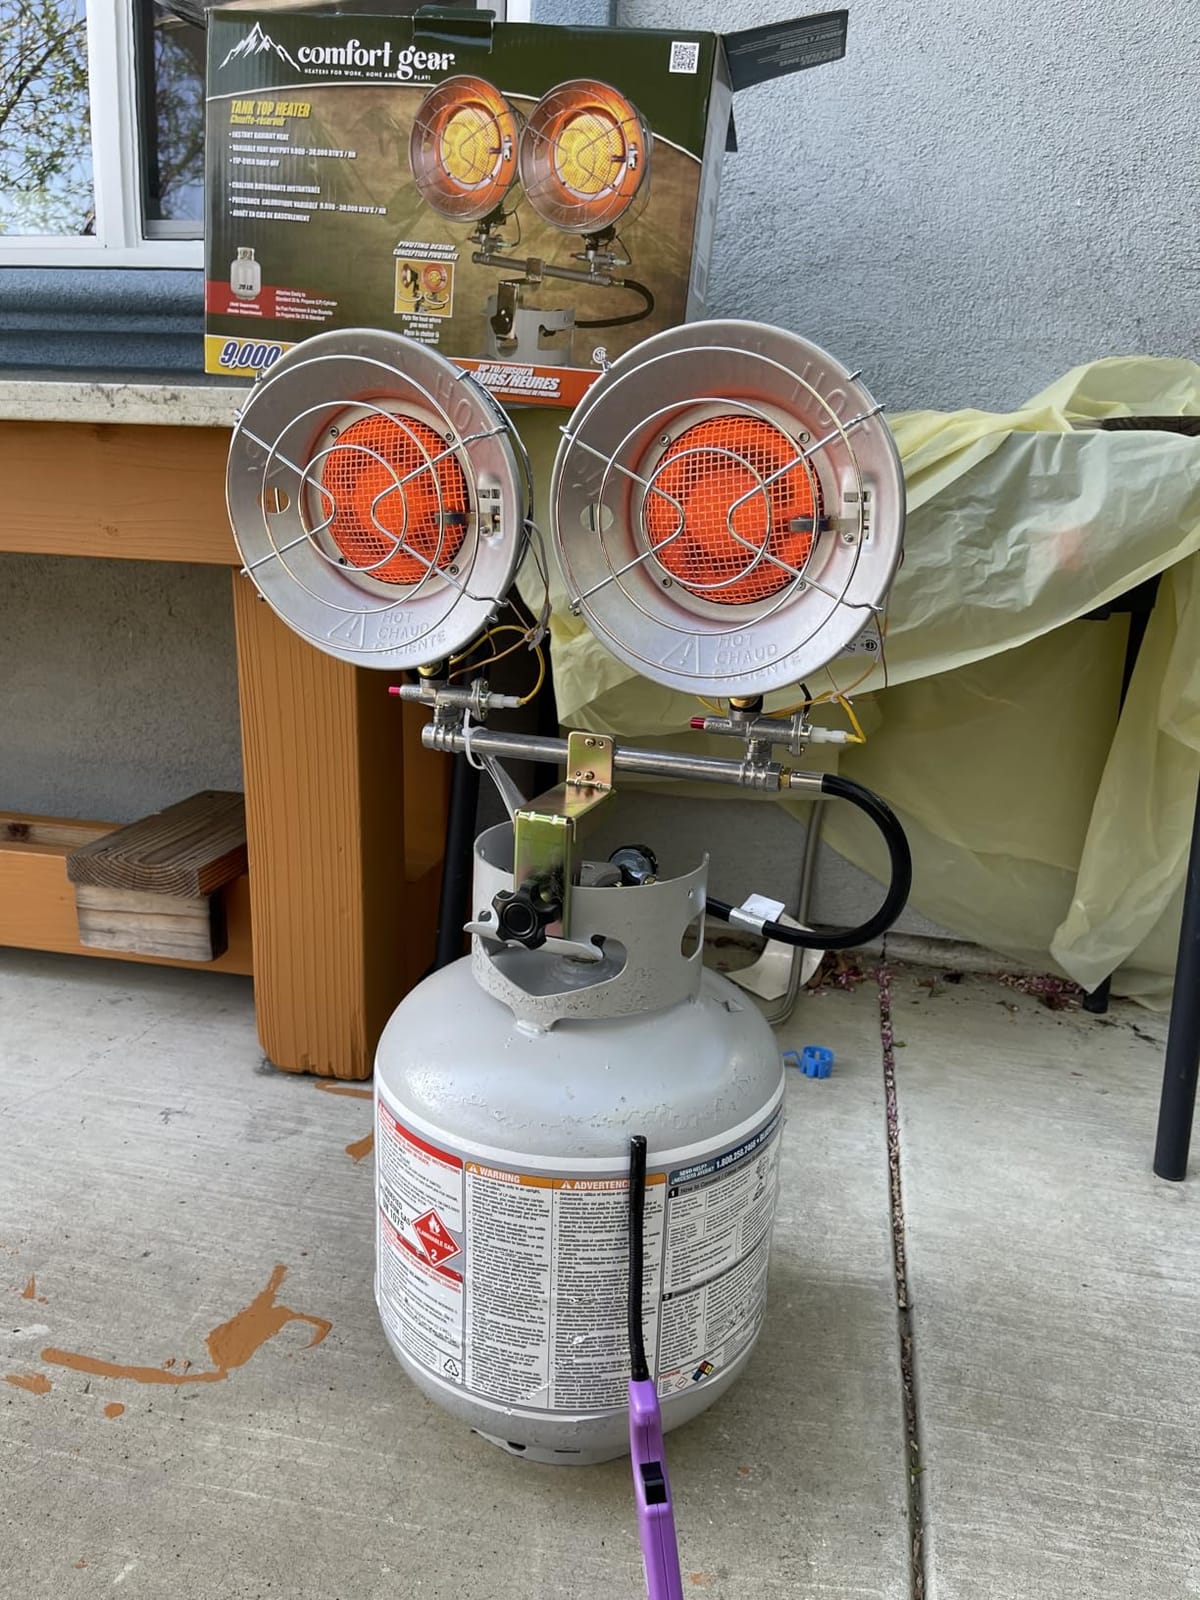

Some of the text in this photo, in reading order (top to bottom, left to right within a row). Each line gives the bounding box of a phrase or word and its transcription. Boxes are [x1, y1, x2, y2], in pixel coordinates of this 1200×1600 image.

[298, 39, 455, 80] comfort gear
[231, 100, 311, 118] TANK TOP HEATER
[219, 341, 282, 369] 9,000
[470, 371, 560, 391] OURS/HEURES
[381, 611, 414, 624] HOT
[376, 622, 430, 640] CHAUD
[717, 634, 754, 648] HOT
[714, 643, 777, 665] CHAUD
[479, 1166, 520, 1183] WARNING
[574, 1179, 630, 1190] ADVERTENC
[431, 1249, 438, 1261] 2
